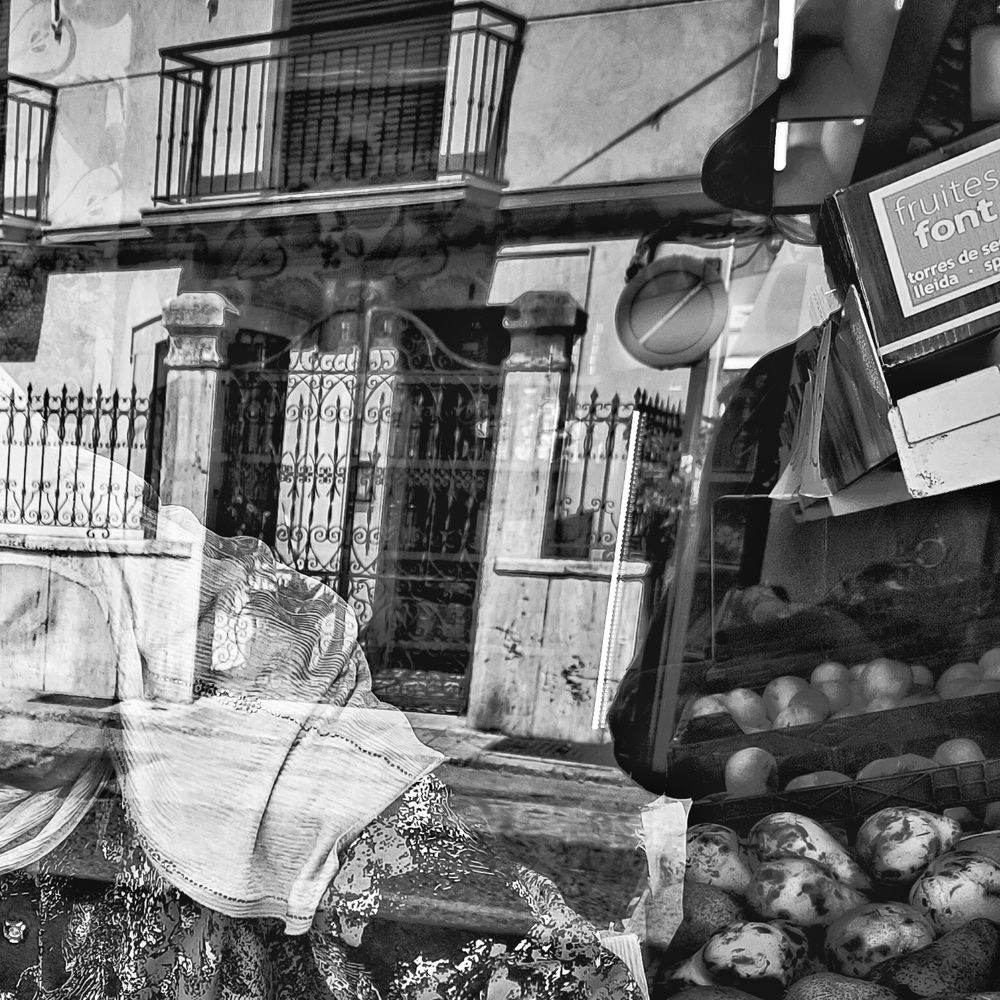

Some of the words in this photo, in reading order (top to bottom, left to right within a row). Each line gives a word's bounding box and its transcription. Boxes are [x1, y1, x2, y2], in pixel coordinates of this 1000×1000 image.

[894, 169, 1000, 226] fruites
[913, 199, 998, 249] font
[907, 258, 956, 284] torres
[958, 249, 979, 265] de
[981, 239, 1000, 256] se
[913, 273, 960, 299] lleida
